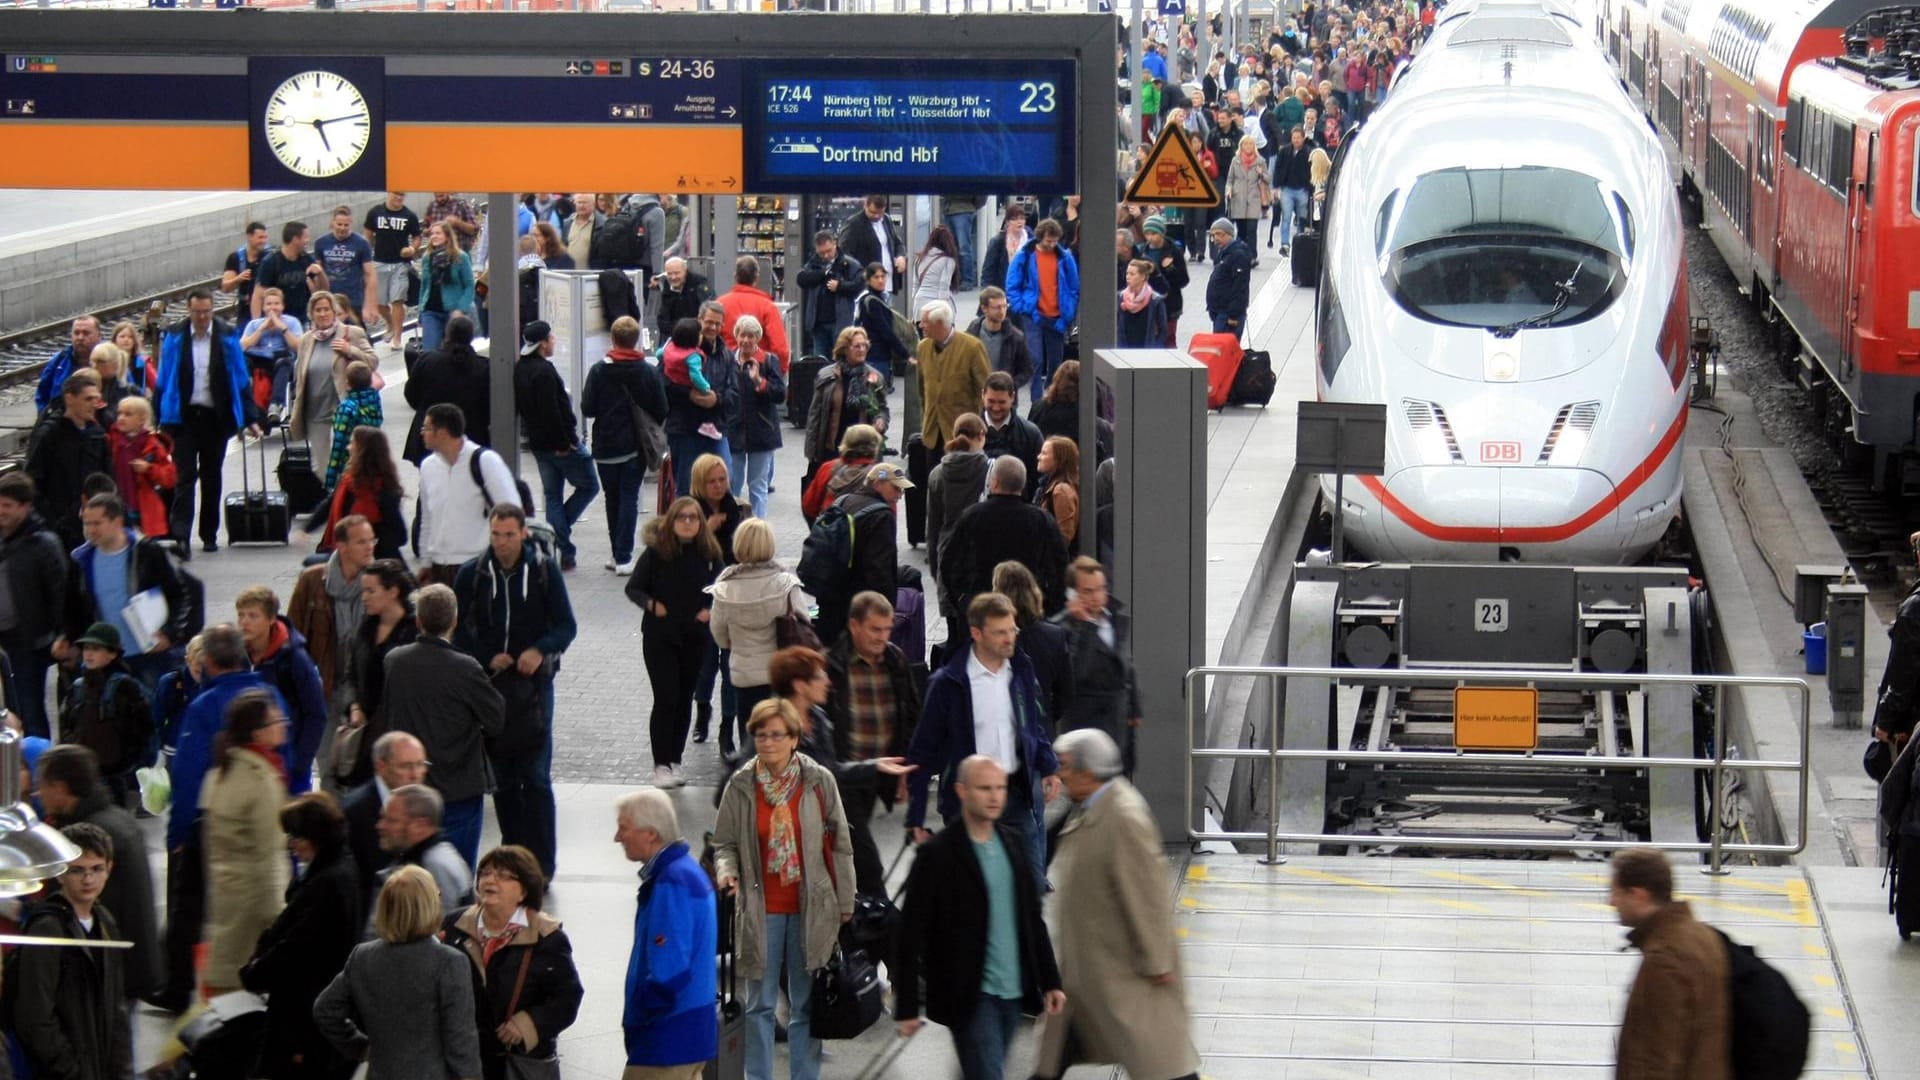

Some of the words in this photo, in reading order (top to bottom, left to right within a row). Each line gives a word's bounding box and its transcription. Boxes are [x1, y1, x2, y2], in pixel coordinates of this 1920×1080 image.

[15, 57, 26, 71] U
[640, 62, 651, 76] S
[660, 60, 715, 79] 24-36
[686, 95, 716, 104] Ausgang
[769, 85, 813, 102] 17:44
[1019, 82, 1056, 113] 23
[823, 95, 870, 107] Nürnberg
[873, 95, 892, 106] Hbf
[908, 95, 958, 107] Würzburg
[961, 95, 980, 106] Hbf
[673, 104, 716, 113] Arnulfstraße
[767, 104, 781, 113] ICE
[783, 104, 799, 113] 526
[823, 107, 872, 117] Frankfurt
[876, 107, 895, 118] Hbf
[911, 106, 968, 118] Düsseldorf
[972, 107, 991, 118] Hbf
[823, 146, 903, 163] Dortmund
[911, 146, 939, 163] Hbf
[1485, 444, 1517, 459] DB
[1481, 604, 1502, 624] 23
